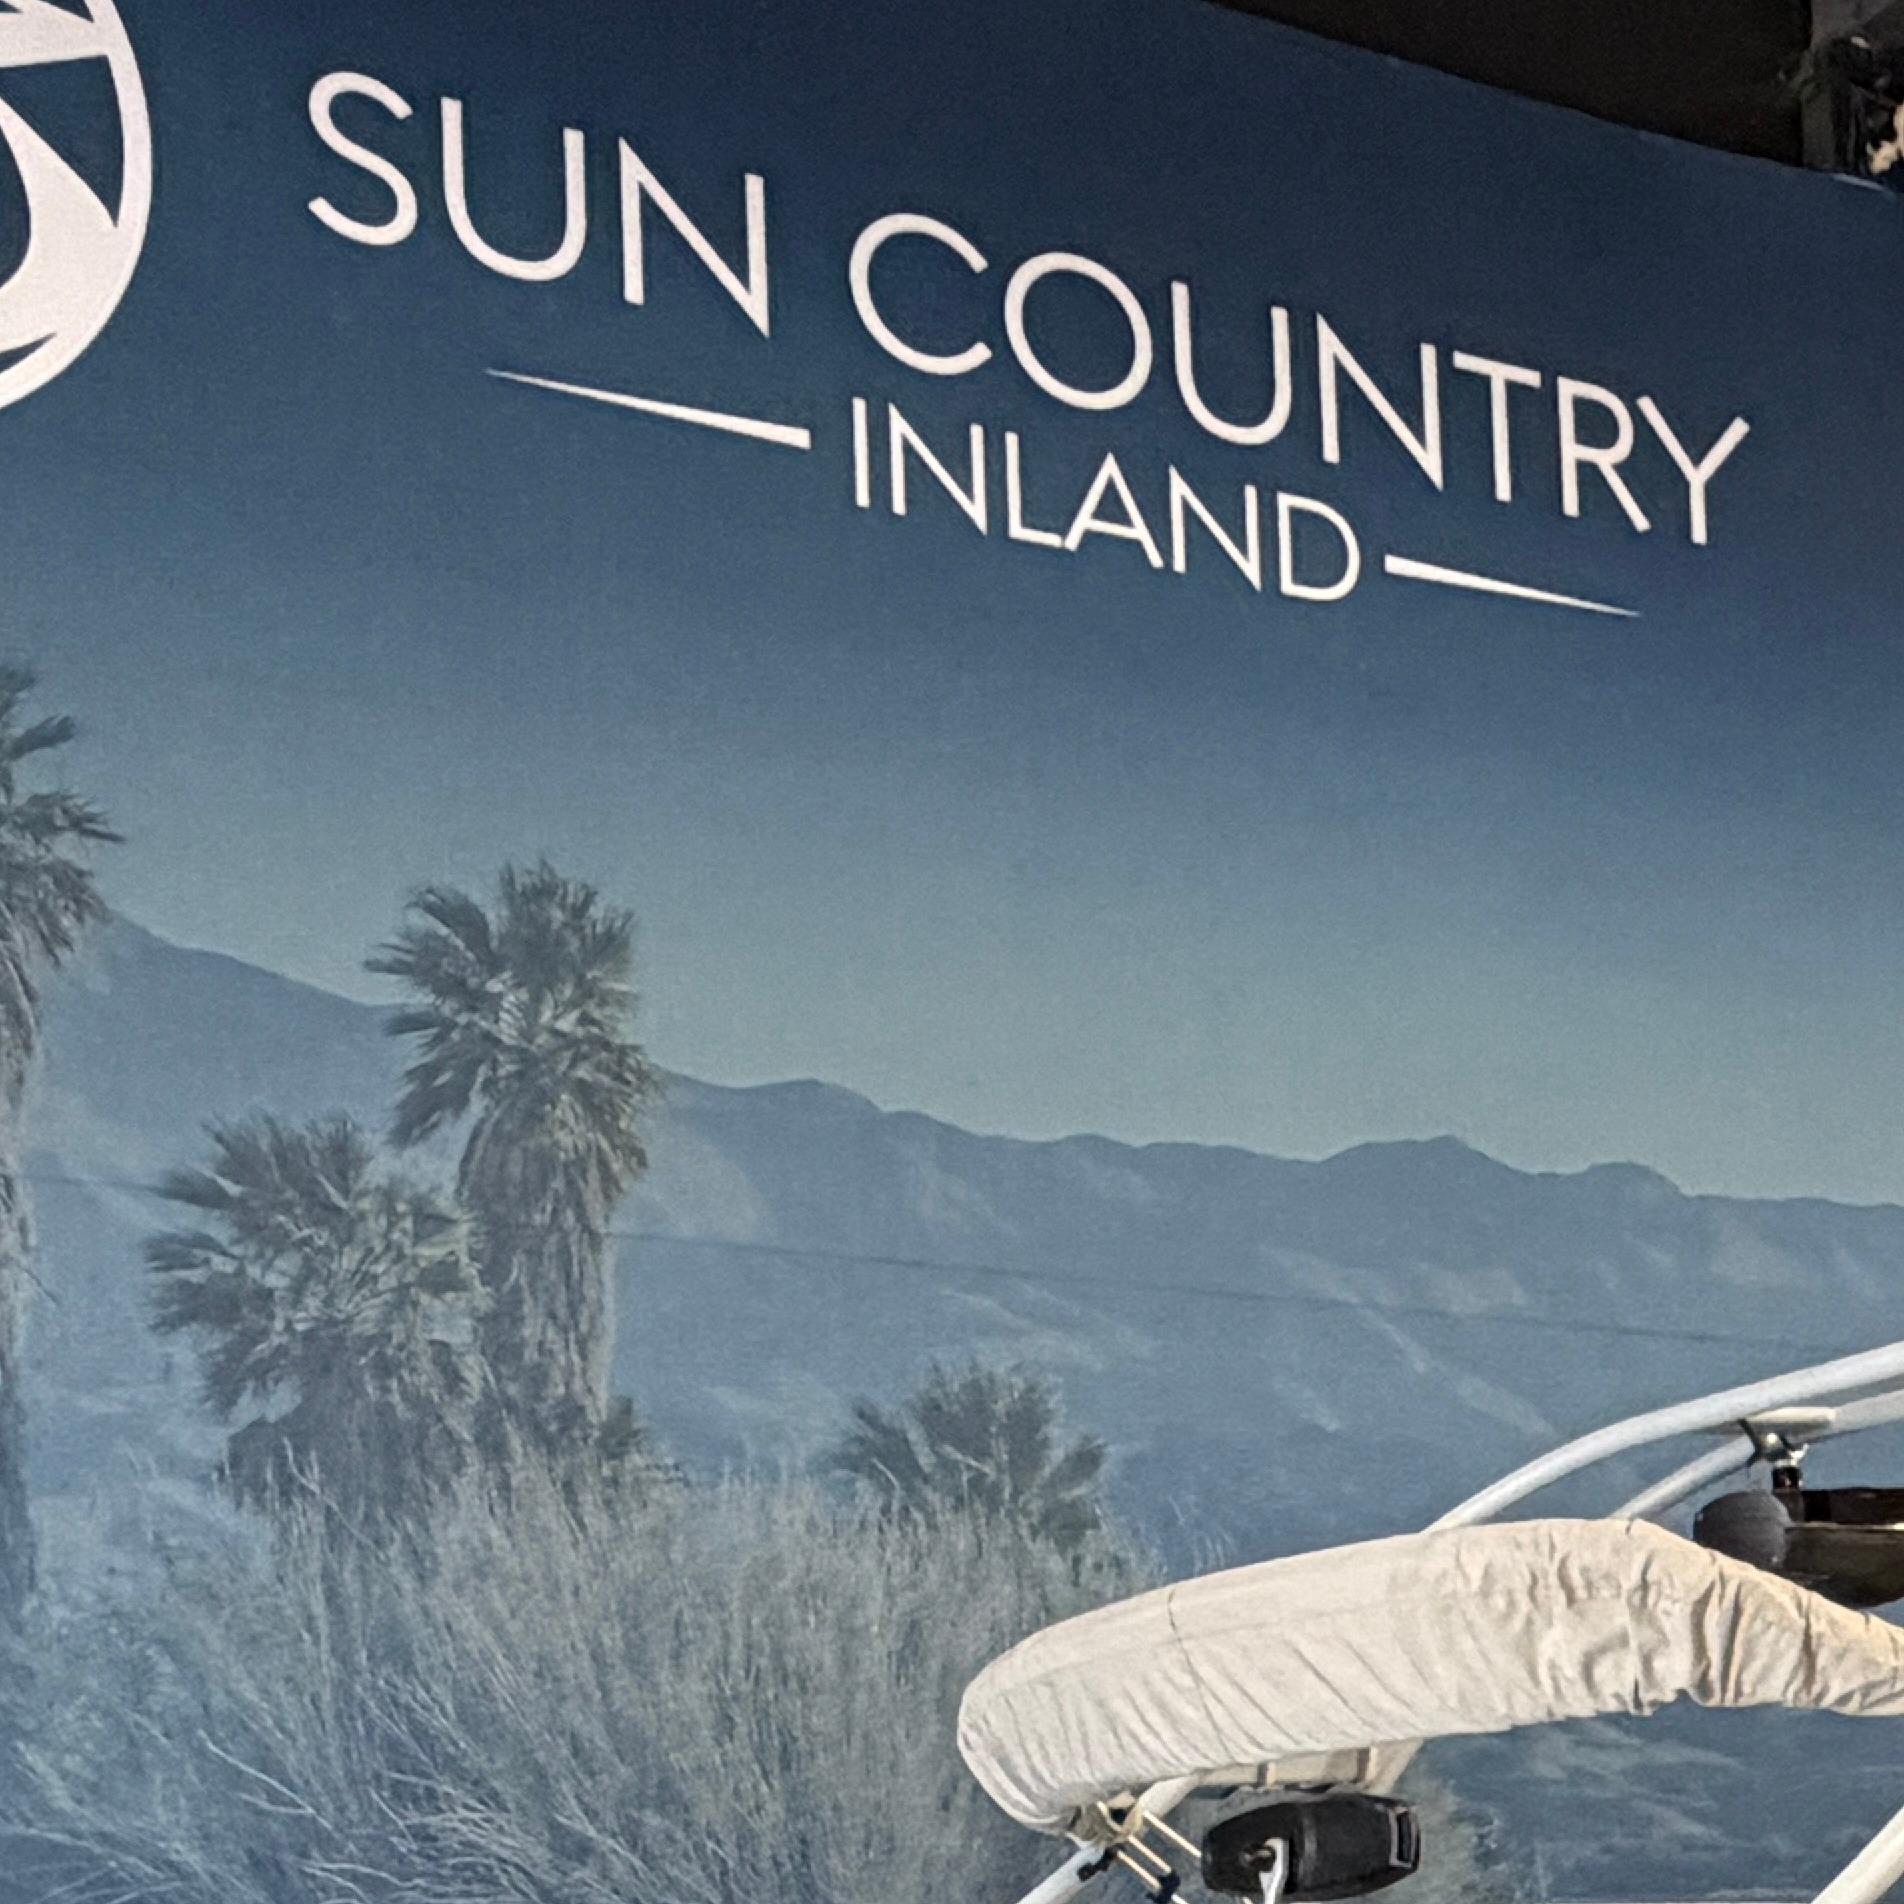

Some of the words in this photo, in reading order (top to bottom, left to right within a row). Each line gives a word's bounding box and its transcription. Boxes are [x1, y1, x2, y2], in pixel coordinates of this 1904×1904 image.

[307, 71, 771, 338] SUN
[848, 212, 1751, 546] COUNTRY
[851, 395, 1361, 602] INLAND
